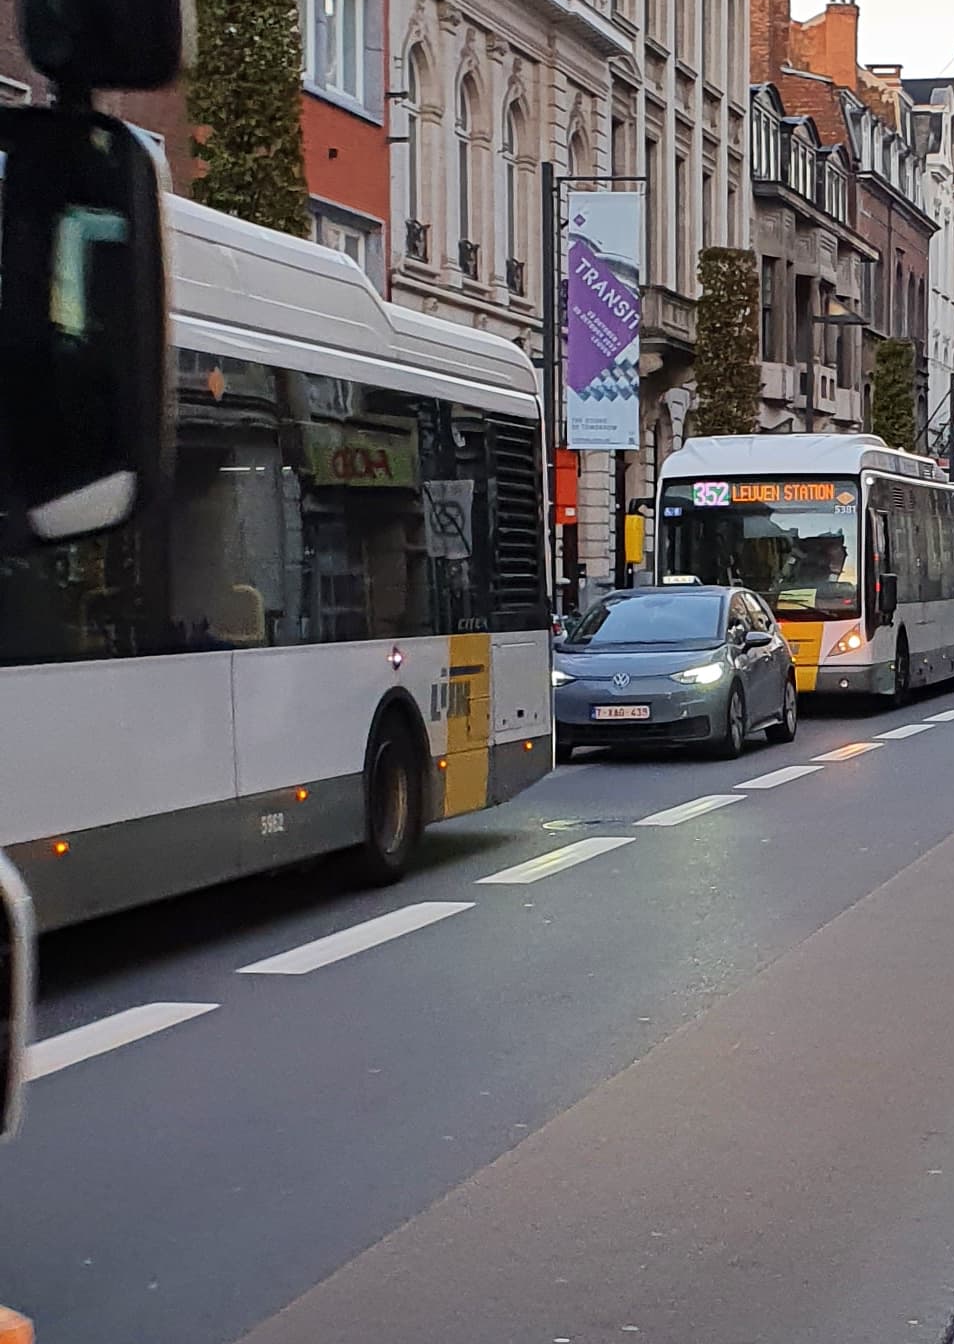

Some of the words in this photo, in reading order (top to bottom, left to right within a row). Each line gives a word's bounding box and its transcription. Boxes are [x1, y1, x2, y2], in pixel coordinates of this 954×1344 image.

[693, 482, 730, 506] 352
[732, 485, 780, 502] LEUVEN
[784, 484, 834, 501] STATION
